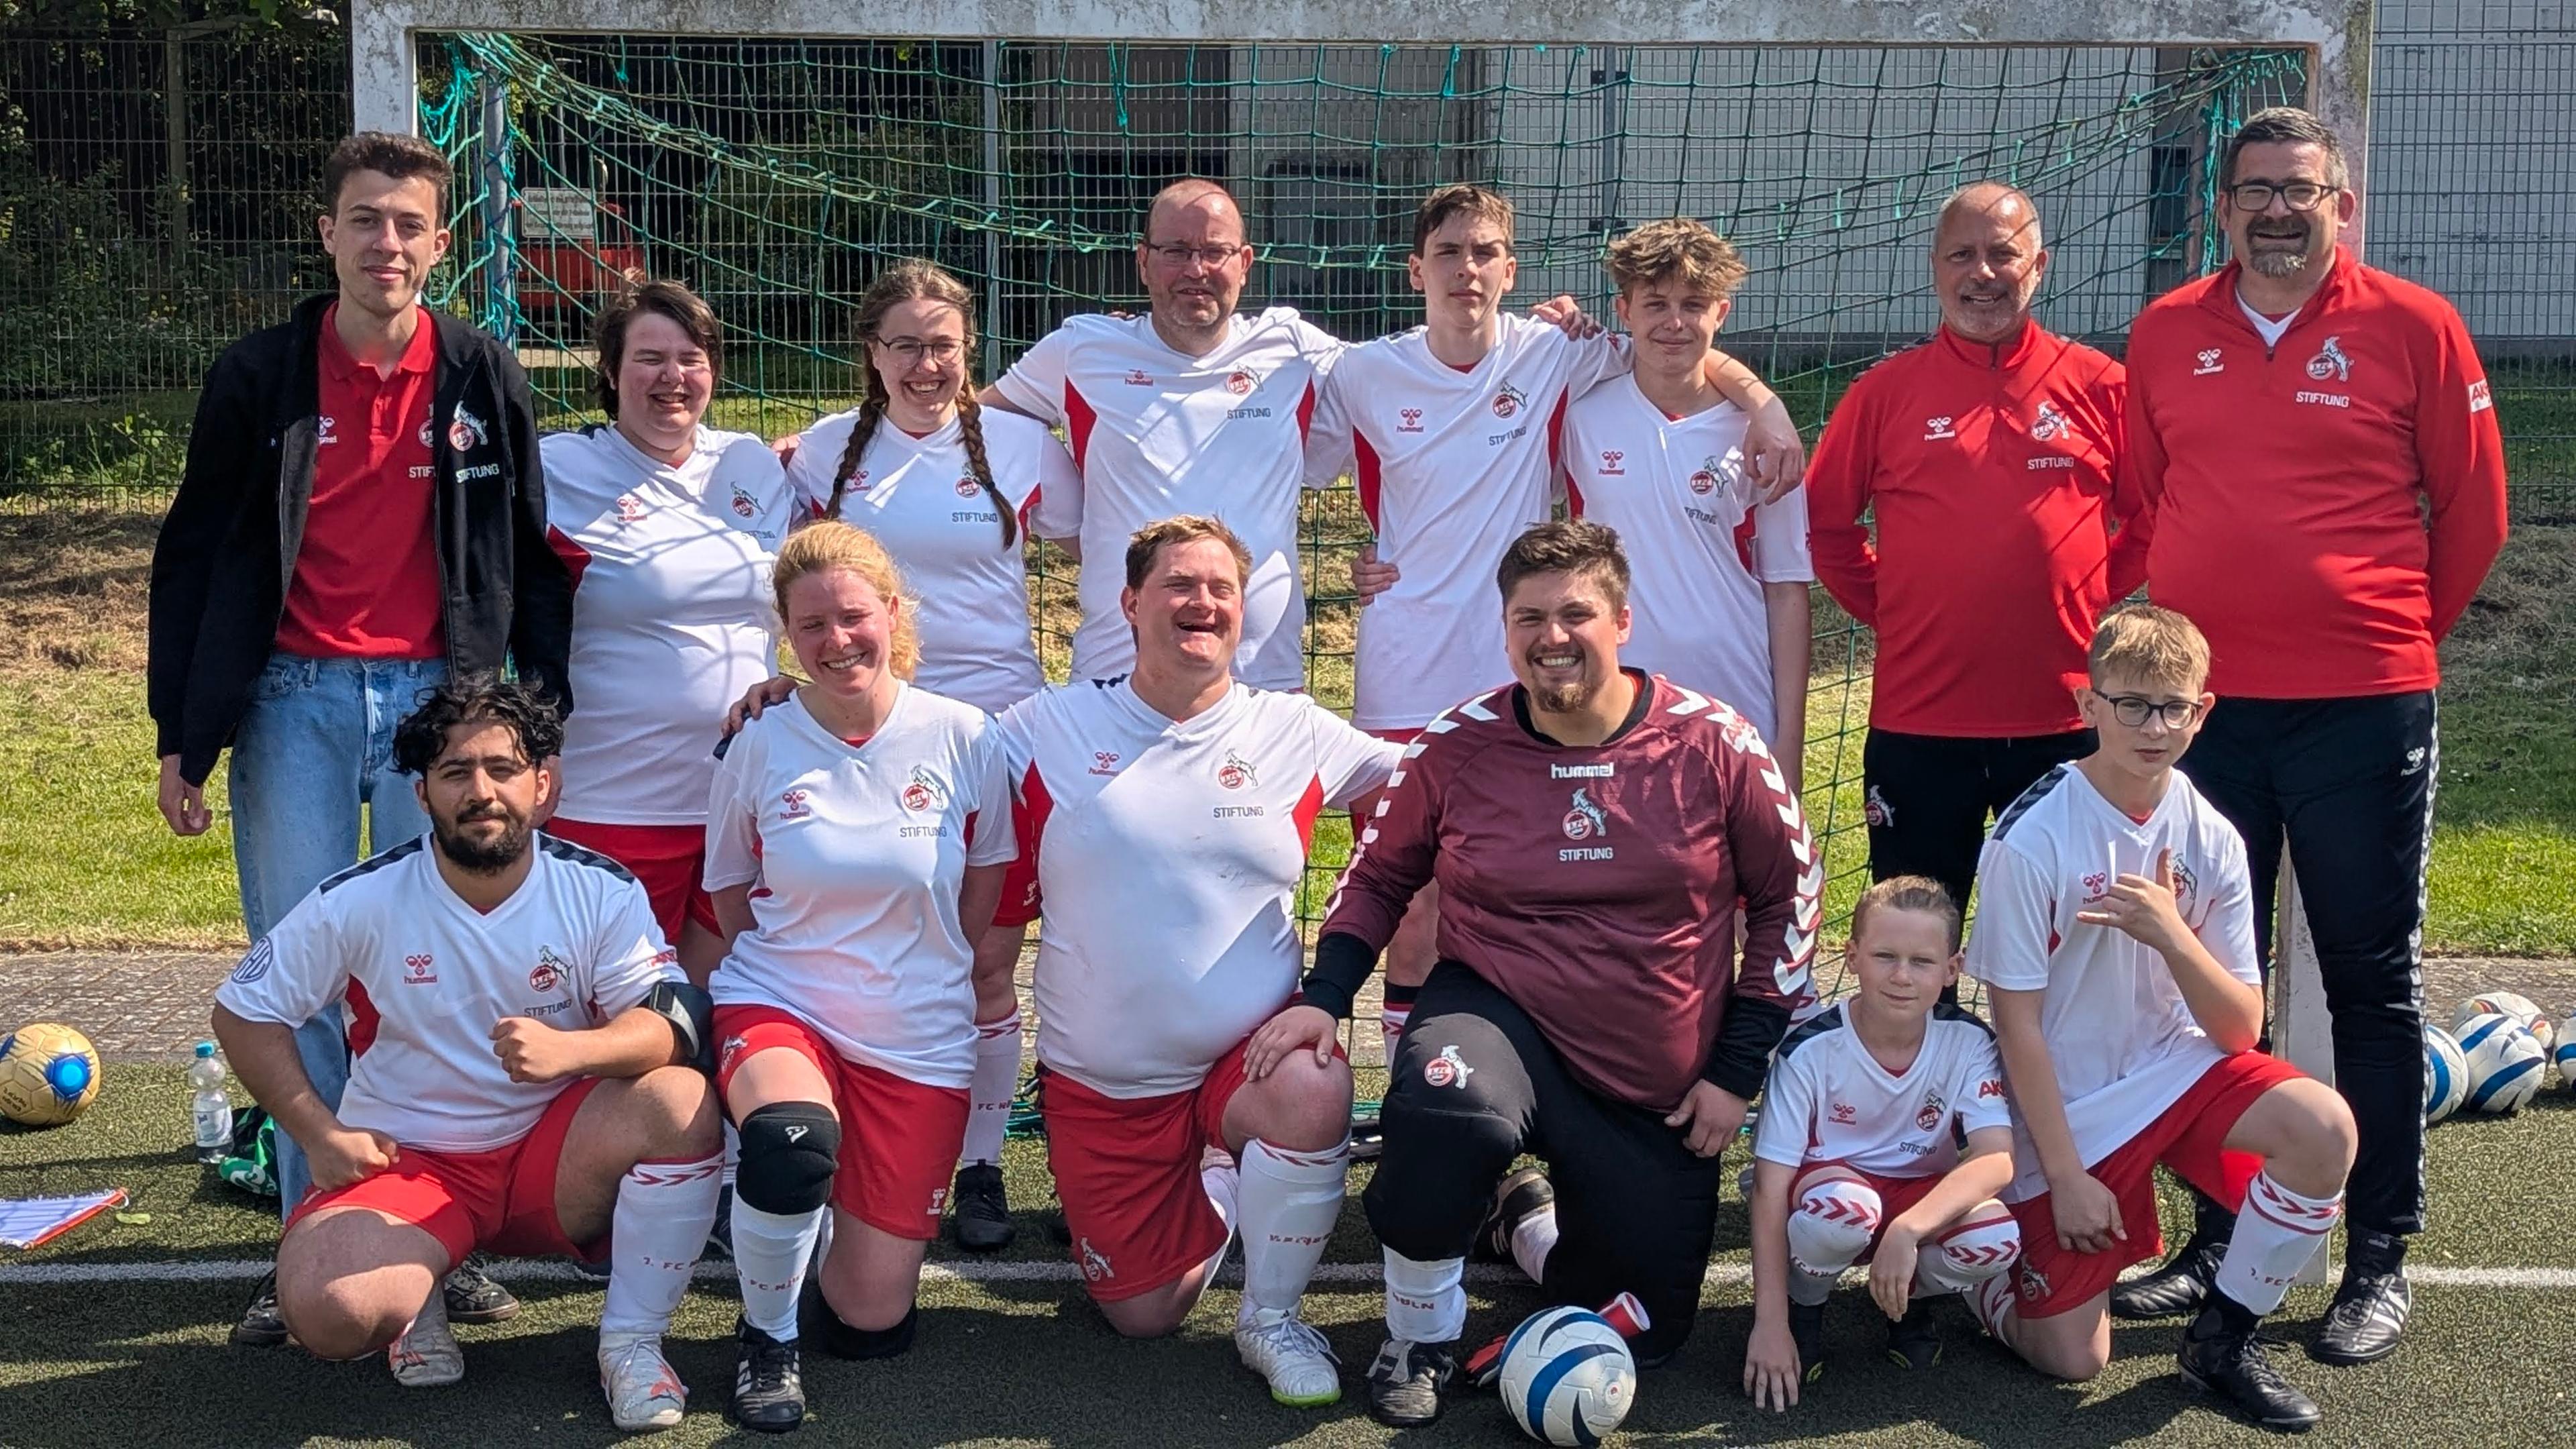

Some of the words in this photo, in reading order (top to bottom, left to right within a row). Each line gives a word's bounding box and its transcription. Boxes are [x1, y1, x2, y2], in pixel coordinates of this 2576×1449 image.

[2296, 391, 2349, 408] STIFTUNG
[1227, 407, 1271, 419] STIFTUNG
[2027, 457, 2074, 470] STIFTUNG
[952, 512, 998, 523] STIFTUNG
[1551, 762, 1614, 779] hummel
[1213, 806, 1264, 818] STIFTUNG
[900, 826, 947, 838] STIFTUNG
[1559, 847, 1613, 861] STIFTUNG
[524, 999, 572, 1017] STIFTUNG
